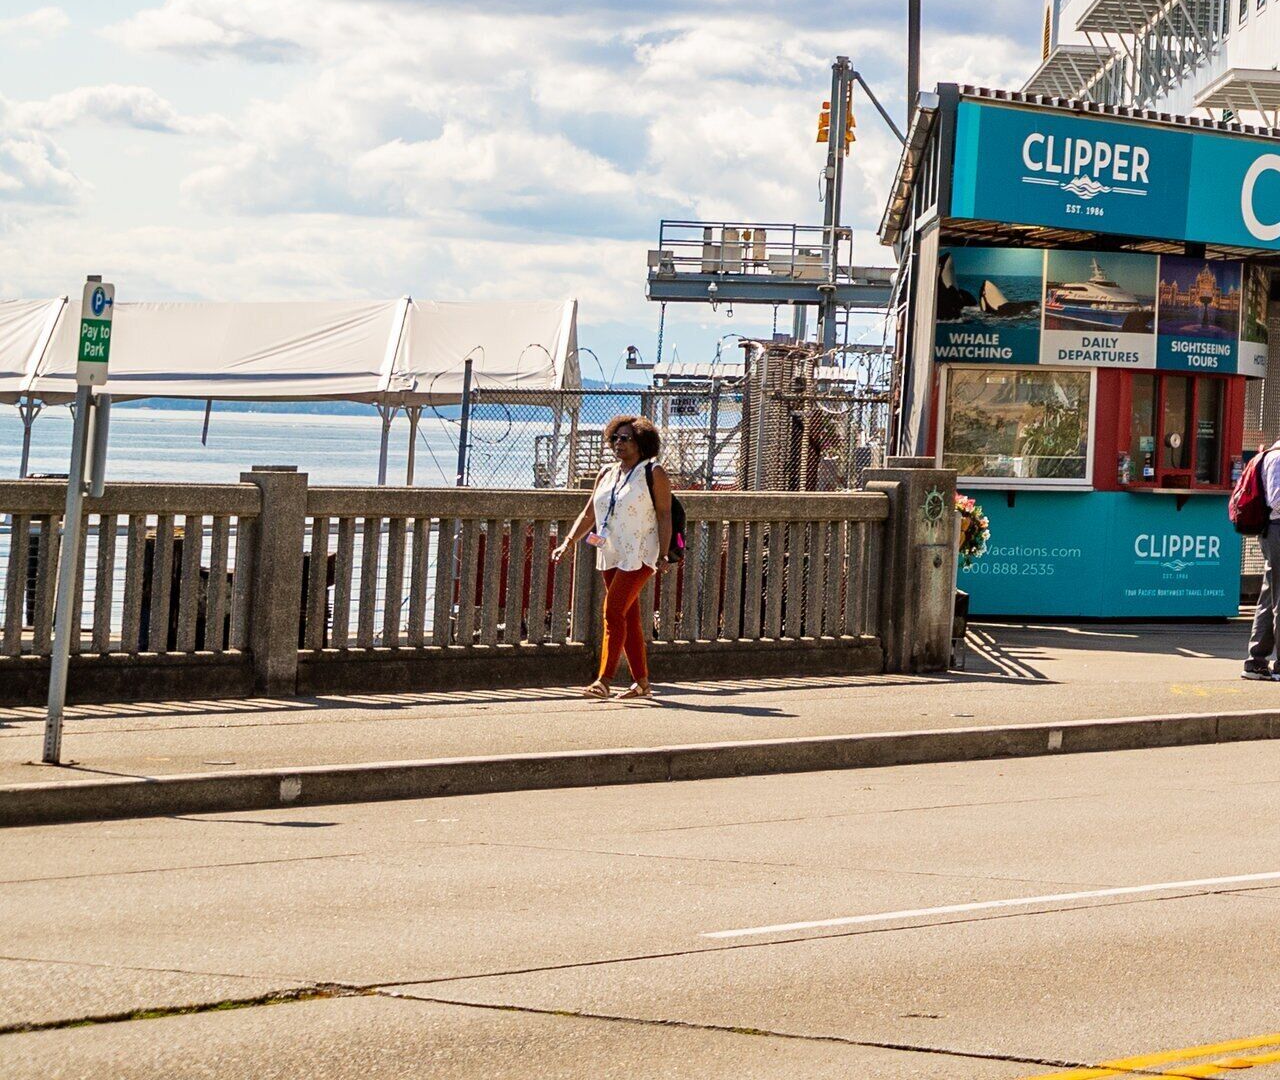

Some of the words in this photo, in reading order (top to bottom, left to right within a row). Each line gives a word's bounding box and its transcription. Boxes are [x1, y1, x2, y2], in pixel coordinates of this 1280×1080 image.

[1022, 132, 1150, 184] CLIPPER
[1066, 204, 1084, 214] EST.
[1086, 206, 1104, 216] 1986
[95, 293, 103, 310] P
[82, 322, 98, 340] Pay
[100, 324, 110, 338] to
[949, 332, 1000, 346] WHALE
[1082, 337, 1119, 348] DAILY
[84, 341, 105, 357] Park
[934, 346, 1013, 359] WATCHING
[1171, 340, 1231, 356] SIGHTSEEING
[1058, 349, 1139, 363] DEPARTURES
[1187, 355, 1218, 368] TOURS
[1134, 534, 1220, 558] CLIPPER
